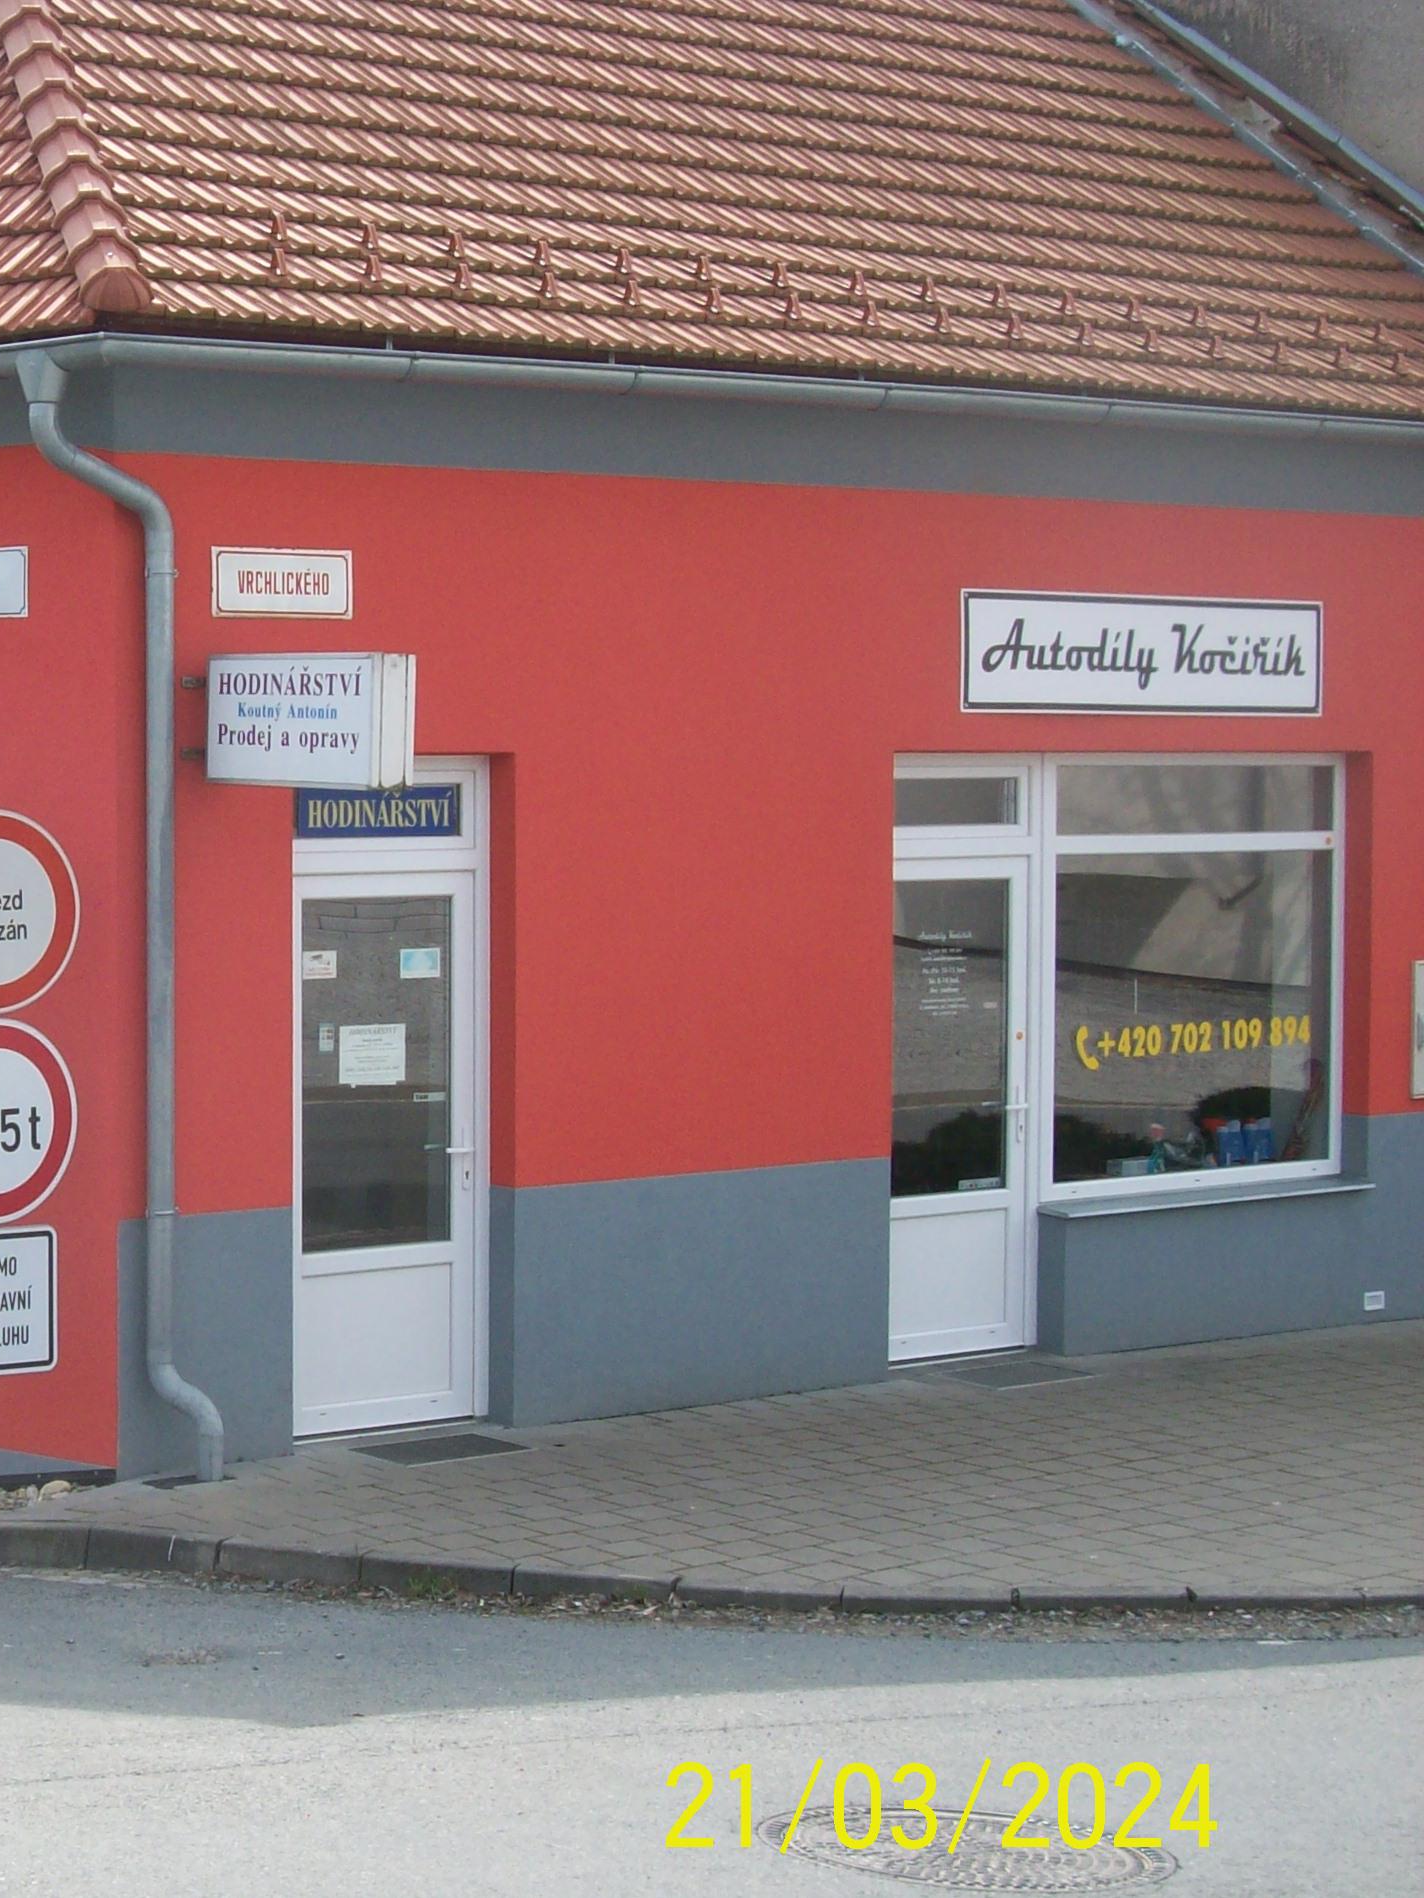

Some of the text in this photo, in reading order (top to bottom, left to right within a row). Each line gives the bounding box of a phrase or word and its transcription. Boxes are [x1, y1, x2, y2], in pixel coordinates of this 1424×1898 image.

[237, 569, 330, 596] VRCHLICKÉHO
[981, 618, 1307, 691] Autodíly Kočiřík
[218, 666, 362, 697] HODINÁŘSTVÍ
[237, 701, 338, 721] Koutný Antonín
[217, 723, 360, 755] Prodej a opravy
[307, 791, 452, 829] HODINÁŘSTVÍ
[1097, 1016, 1311, 1058] +420 702 109 894
